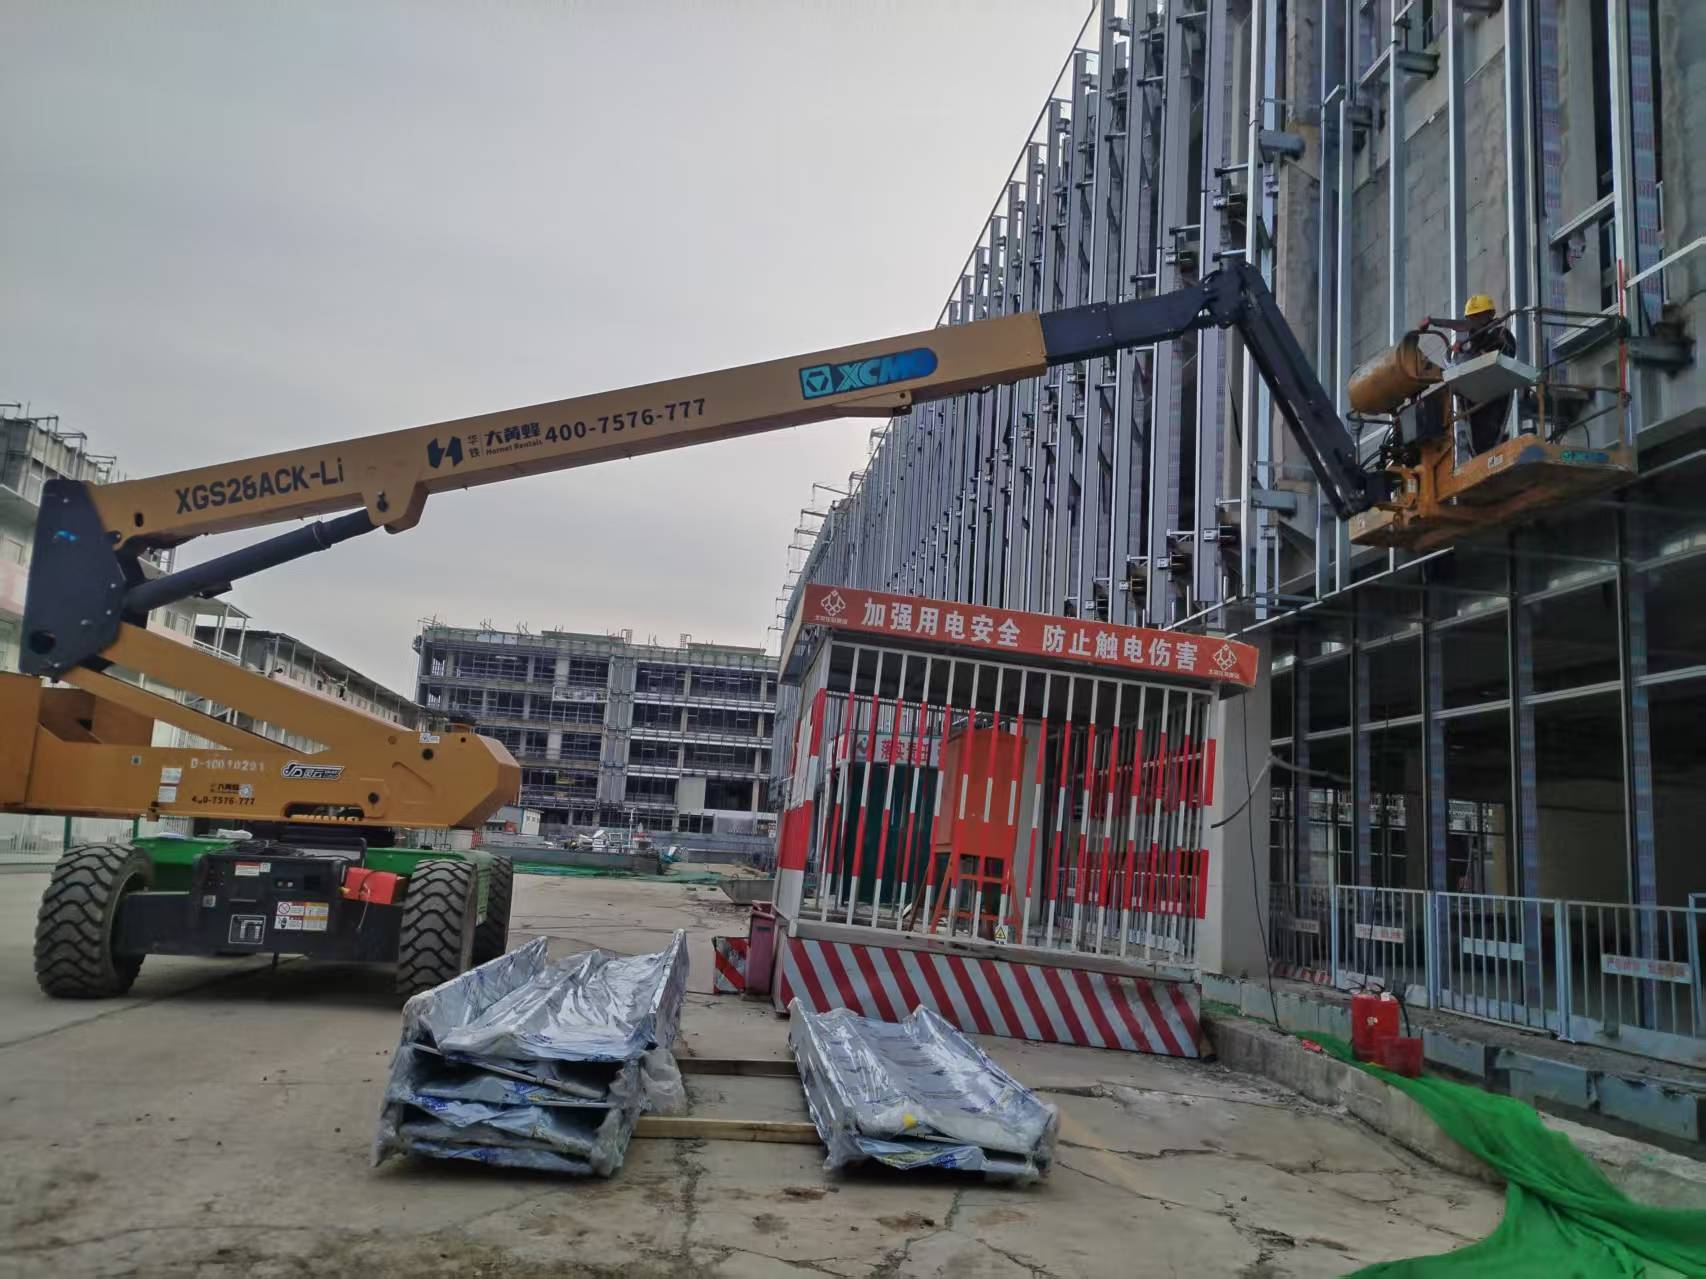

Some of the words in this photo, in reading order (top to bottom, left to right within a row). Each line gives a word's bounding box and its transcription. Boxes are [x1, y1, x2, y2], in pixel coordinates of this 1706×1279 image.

[545, 398, 706, 443] 400-7576-777
[860, 597, 1021, 647] 加强用电安全
[1042, 624, 1198, 672] 防止触电伤害
